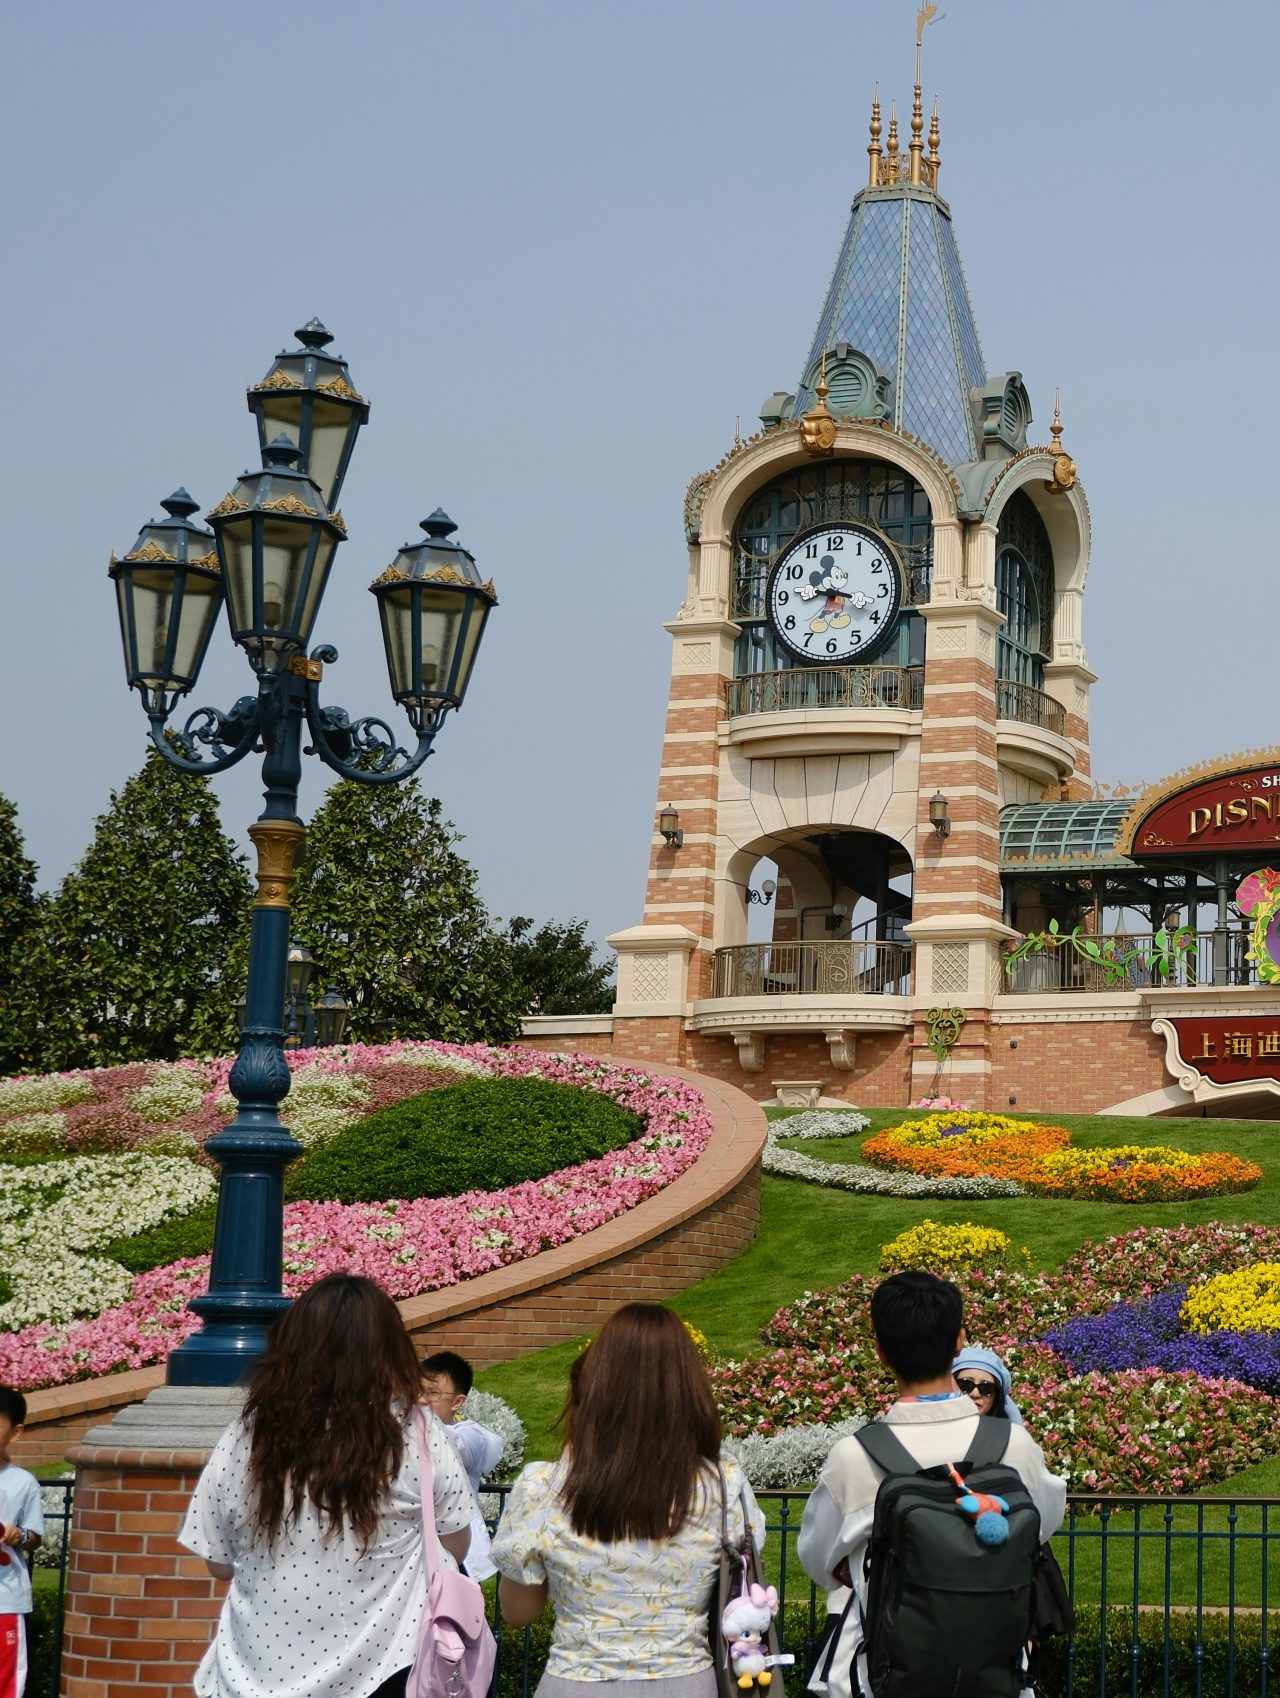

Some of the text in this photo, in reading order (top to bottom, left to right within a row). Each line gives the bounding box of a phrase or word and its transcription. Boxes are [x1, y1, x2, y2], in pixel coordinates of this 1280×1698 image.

[805, 543, 817, 559] 11
[826, 536, 844, 551] 12
[856, 541, 862, 556] 1
[785, 565, 804, 580] 10
[871, 558, 883, 573] 2
[877, 583, 889, 598] 3
[778, 591, 789, 606] 9
[784, 615, 796, 630] 8
[869, 610, 881, 625] 4
[803, 632, 814, 648] 7
[850, 630, 862, 645] 5
[825, 638, 838, 653] 6
